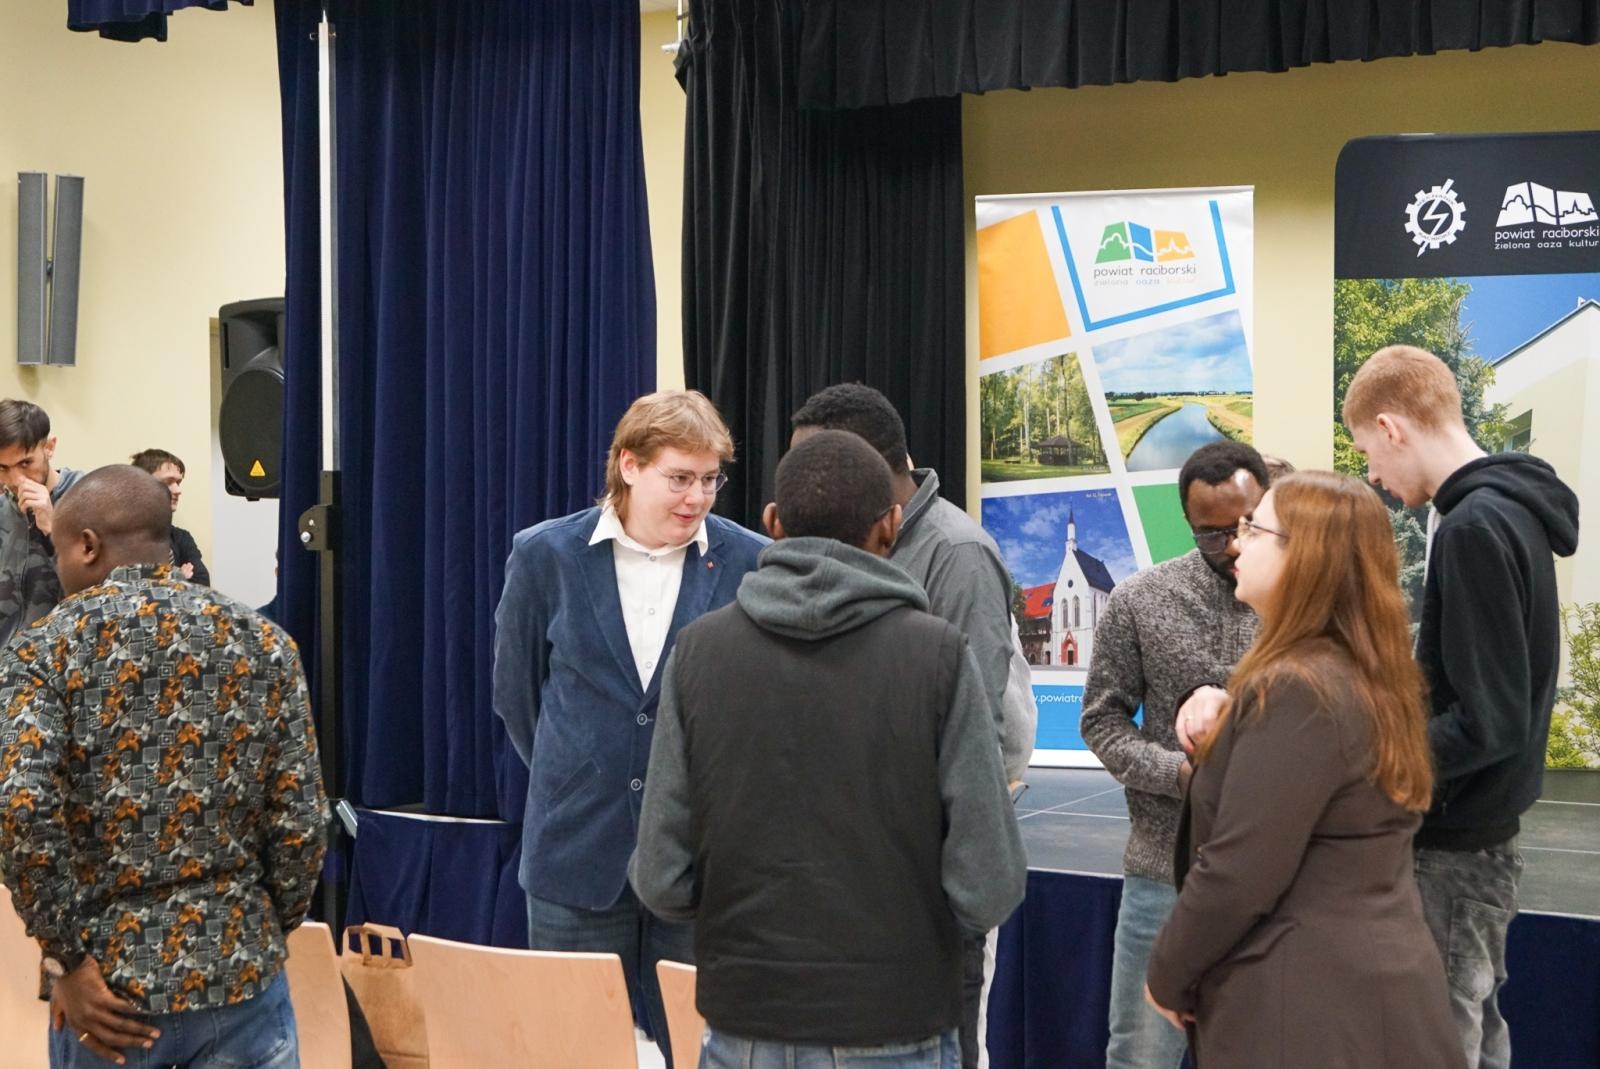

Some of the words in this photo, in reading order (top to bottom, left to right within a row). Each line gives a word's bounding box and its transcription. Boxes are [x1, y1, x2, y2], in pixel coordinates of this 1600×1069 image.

[1494, 228, 1535, 242] powiat
[1542, 226, 1600, 239] raciborski
[1494, 241, 1531, 250] zielona
[1537, 241, 1563, 249] oaza
[1093, 265, 1134, 279] powiat
[1140, 263, 1197, 276] raciborski
